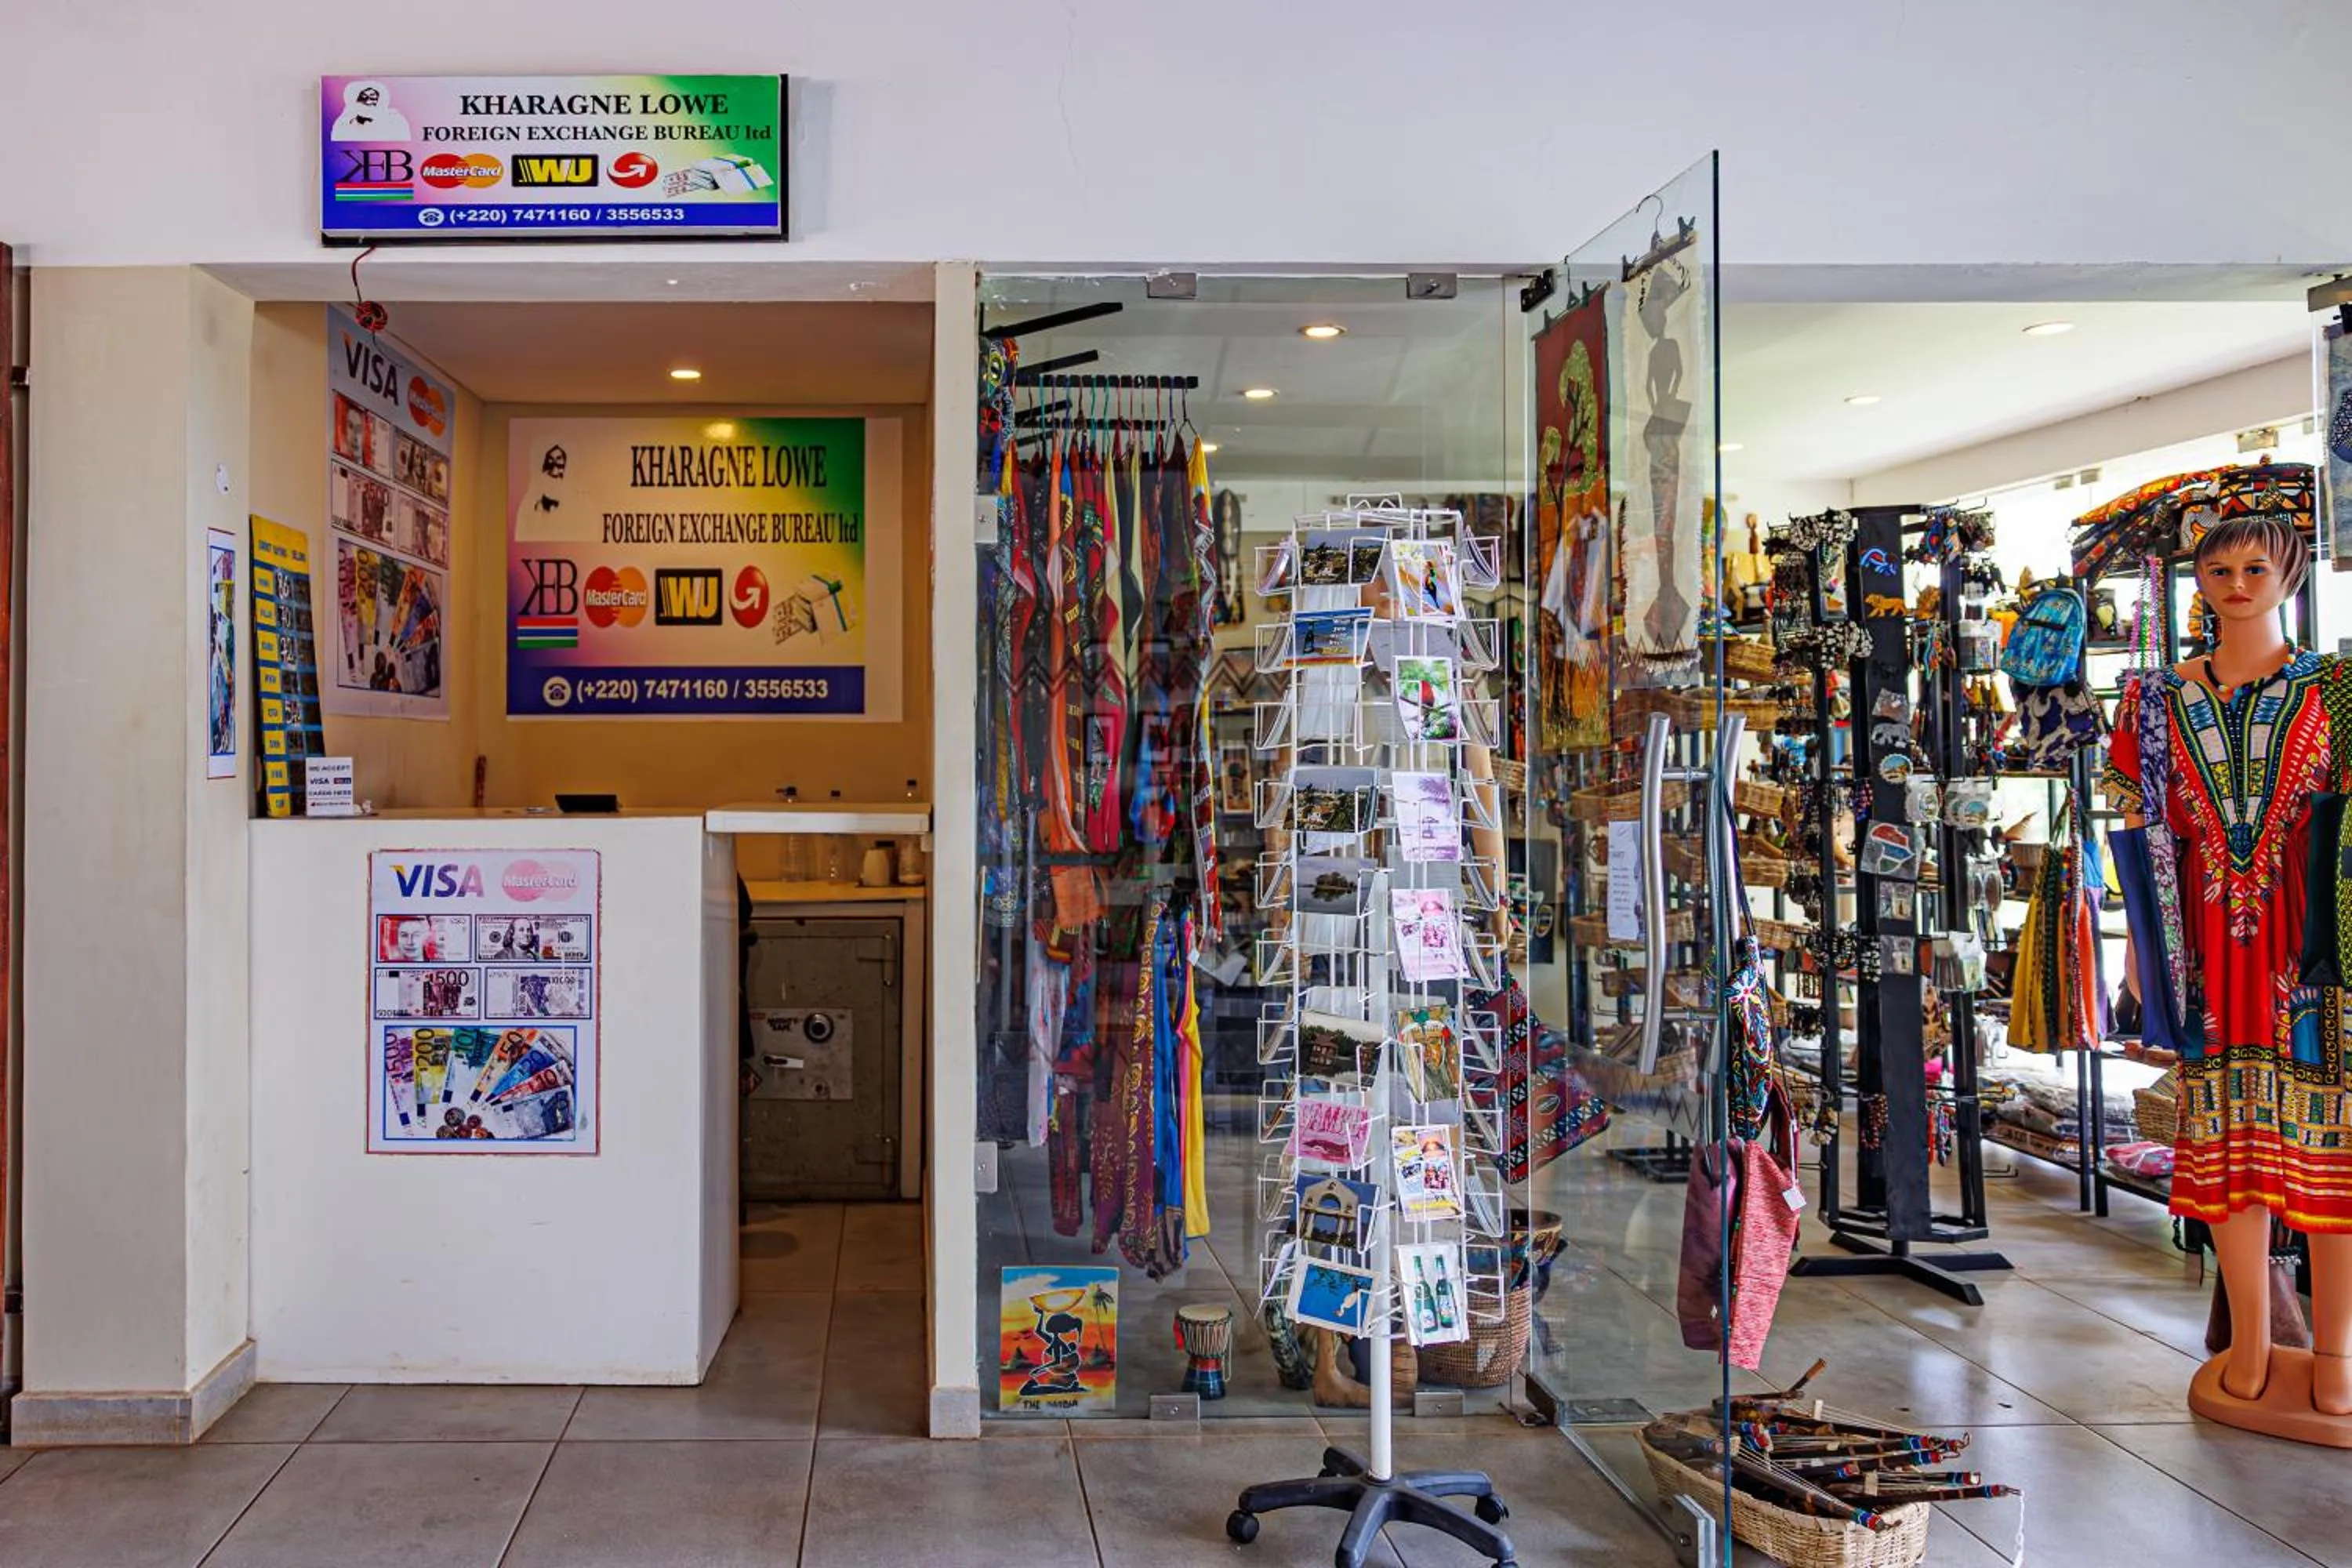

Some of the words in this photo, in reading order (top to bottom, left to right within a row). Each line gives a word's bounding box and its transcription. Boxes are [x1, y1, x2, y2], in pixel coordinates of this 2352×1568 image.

[459, 94, 631, 115] KHARAGNE
[640, 94, 728, 115] LOWE
[423, 125, 520, 141] FOREIGN
[527, 125, 648, 140] EXCHANGE
[655, 125, 740, 140] BUREAU
[746, 125, 771, 140] ltd
[423, 165, 503, 178] MasterCard
[527, 159, 592, 183] WU
[449, 209, 507, 224] (+220)
[513, 209, 590, 222] 7471160
[607, 208, 684, 221] 3556533
[340, 329, 399, 406] VISA
[630, 445, 756, 488] KHARAGNE
[761, 445, 827, 488] LOWE
[602, 514, 675, 543] FOREIGN
[679, 514, 768, 543] EXCHANGE
[771, 514, 835, 543] BUREAU
[839, 514, 858, 543] ltd
[586, 589, 648, 607] MasterCard
[666, 576, 718, 618] WU
[577, 679, 638, 702] (+220)
[644, 680, 728, 699] 7471160
[745, 679, 828, 699] 3556533
[390, 865, 485, 897] VISA
[436, 970, 469, 987] 500
